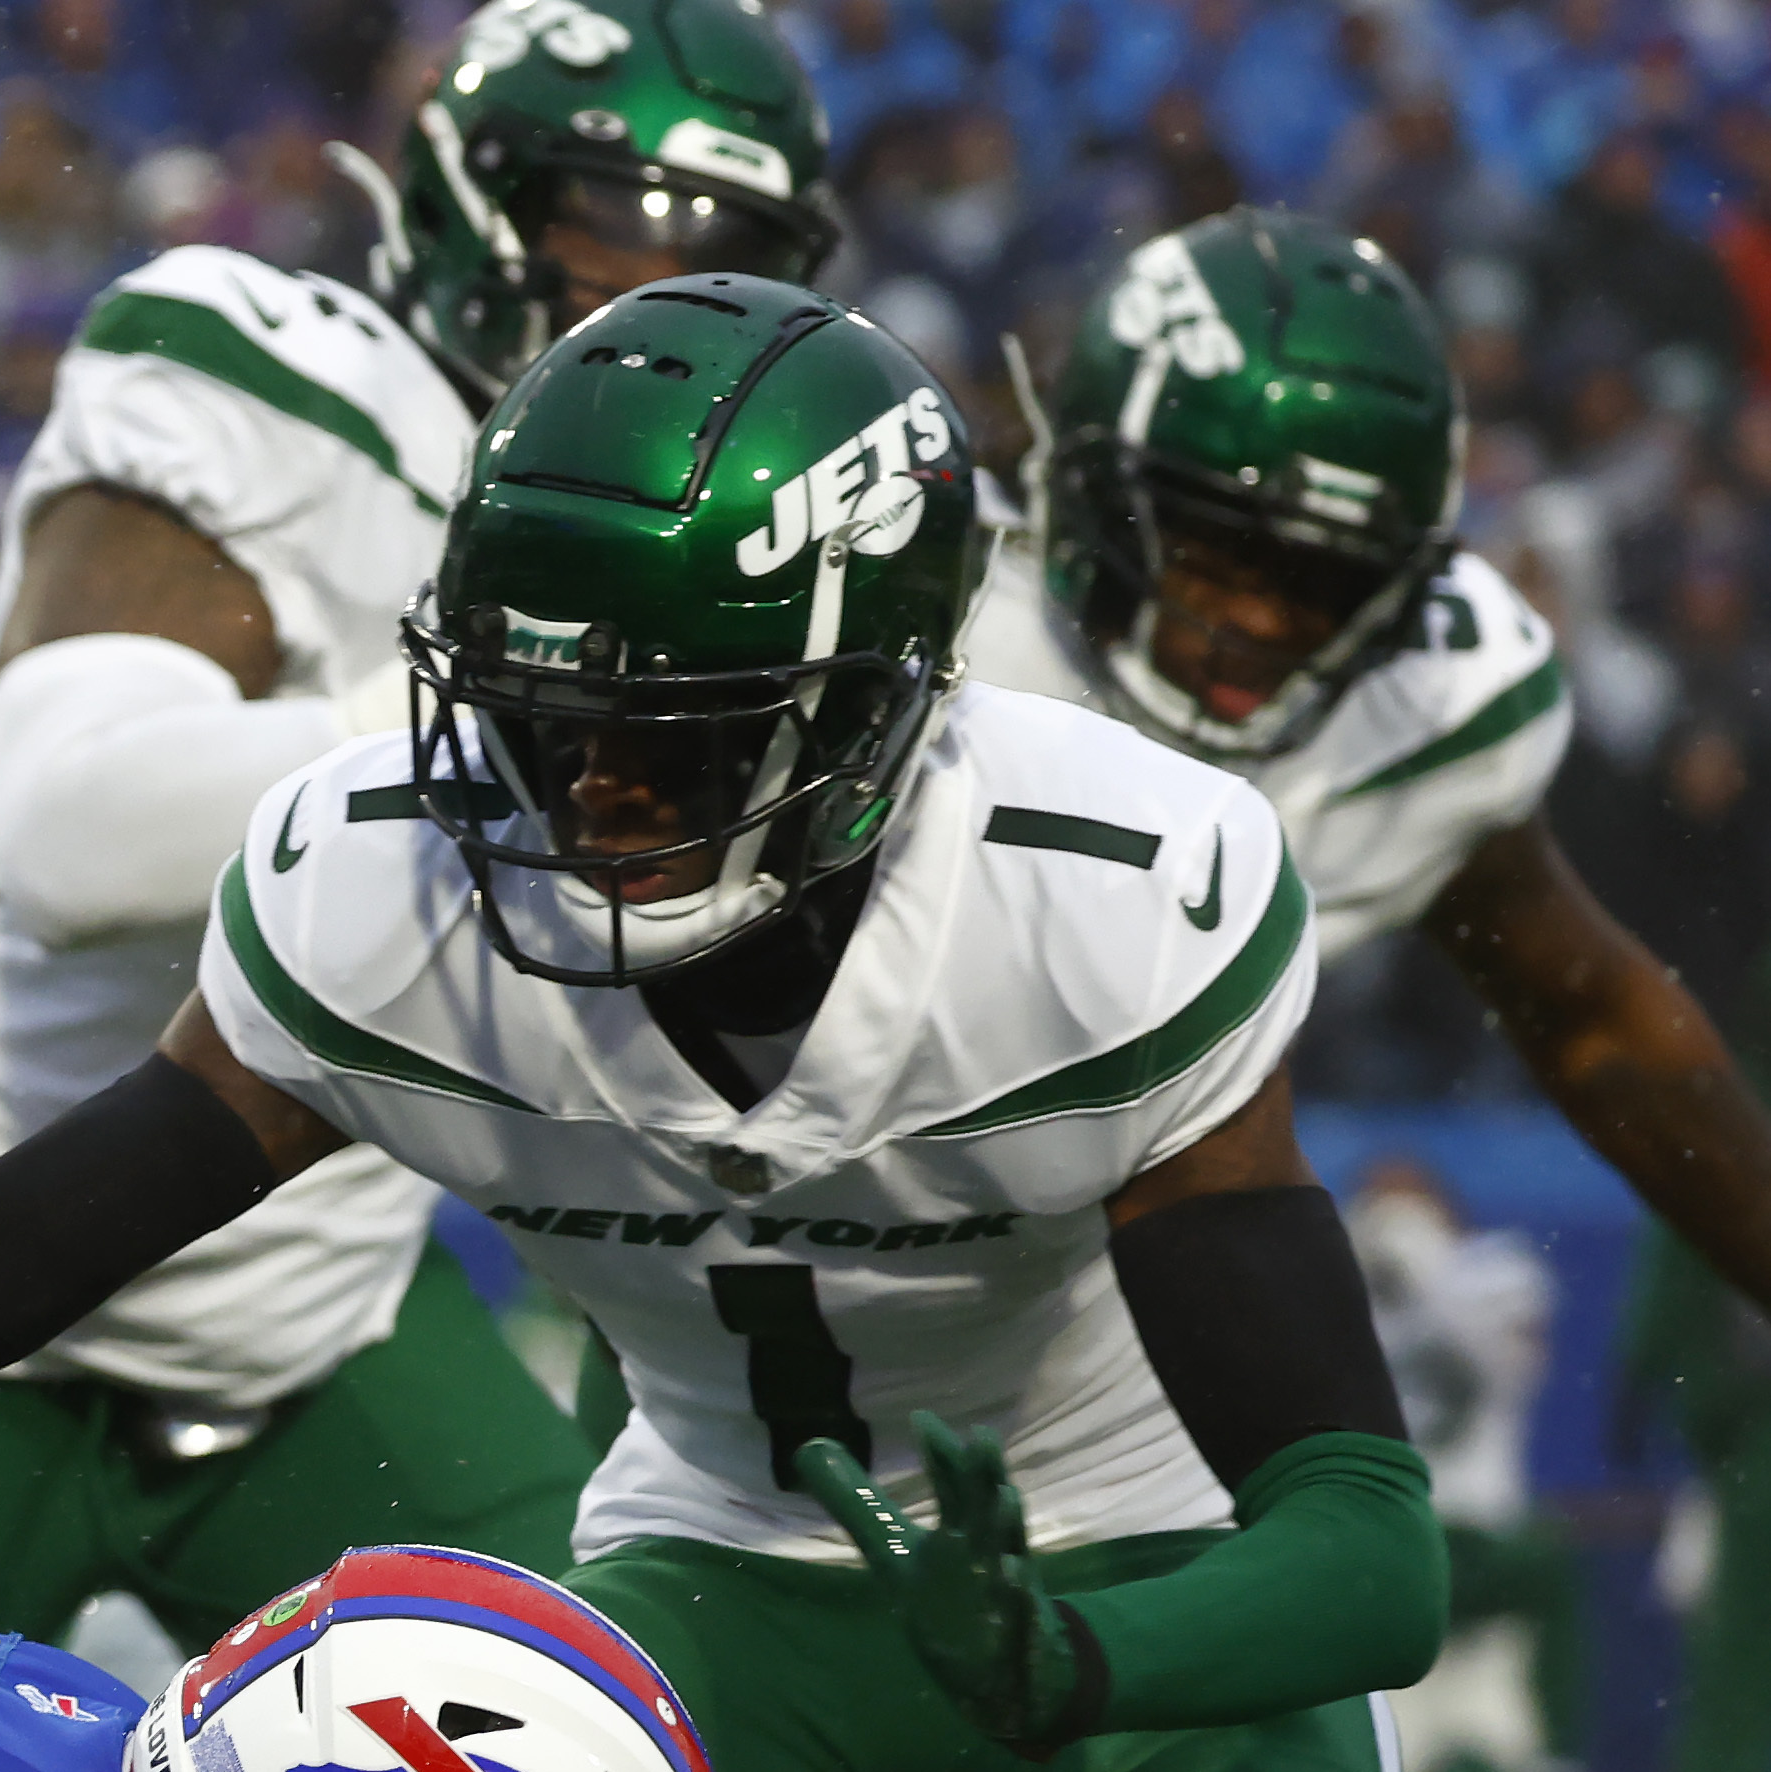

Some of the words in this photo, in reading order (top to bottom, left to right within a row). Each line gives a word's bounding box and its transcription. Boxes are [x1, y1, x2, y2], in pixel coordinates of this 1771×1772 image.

[735, 386, 951, 578] JETS
[983, 805, 1162, 870] 1
[485, 1205, 725, 1248] NEW
[747, 1211, 1027, 1252] YORK
[706, 1262, 873, 1492] 1
